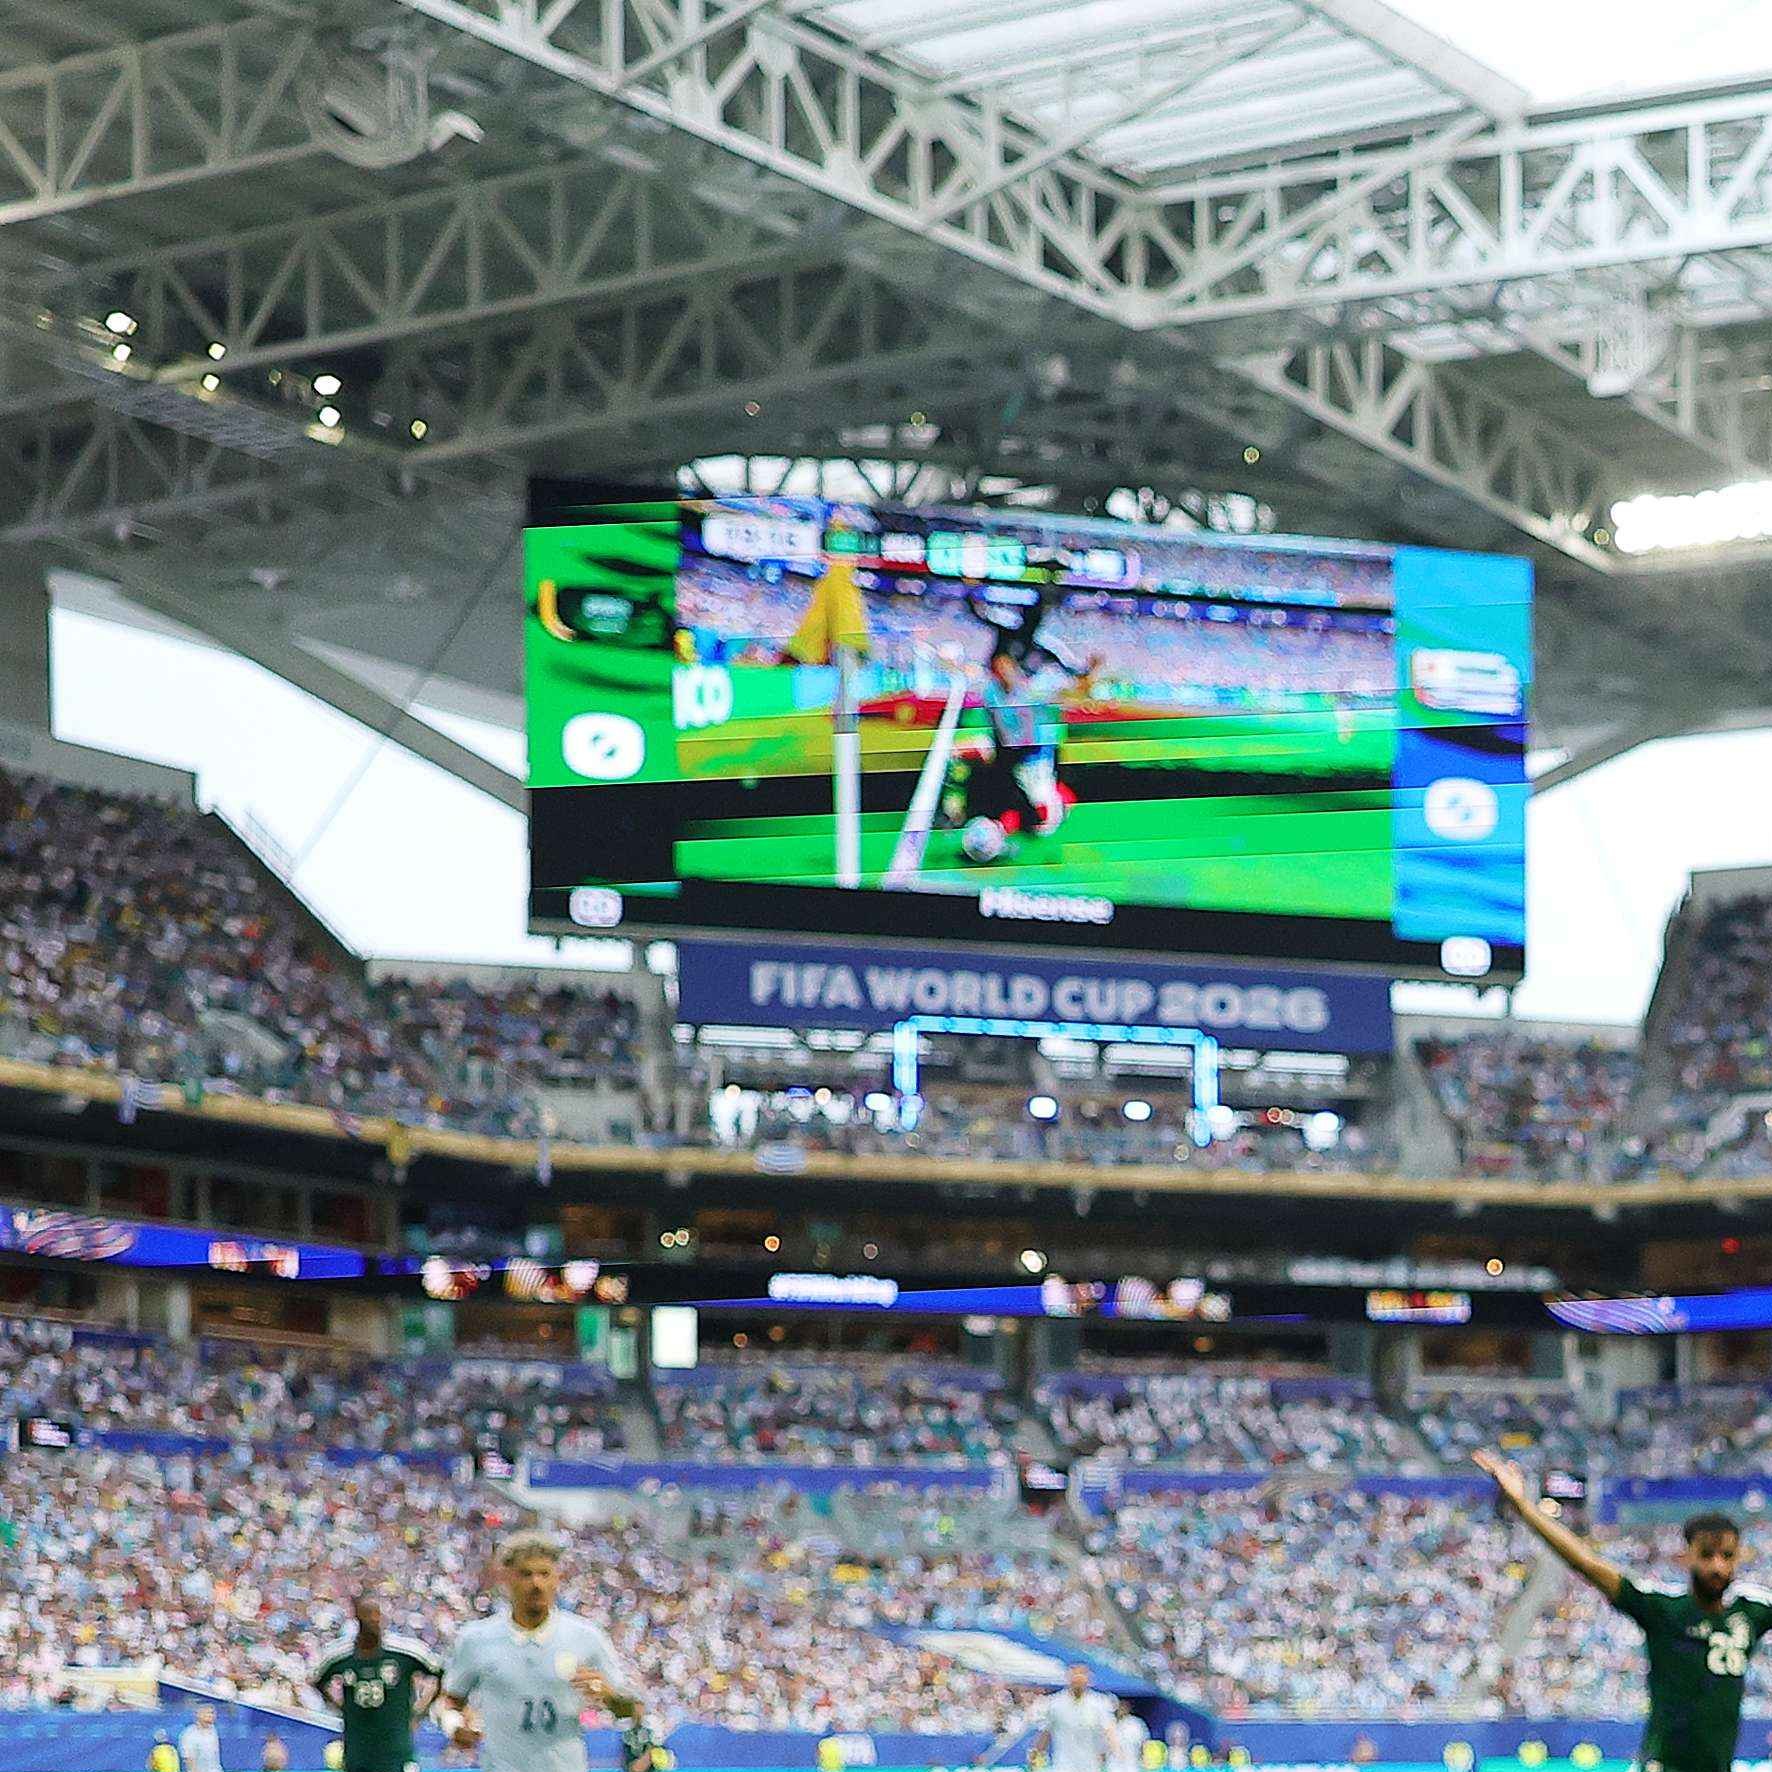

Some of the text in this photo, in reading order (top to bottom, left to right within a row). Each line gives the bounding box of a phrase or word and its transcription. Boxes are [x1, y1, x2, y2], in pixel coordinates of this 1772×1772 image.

[749, 961, 1331, 1032] FIFA WORLD CUP 2026
